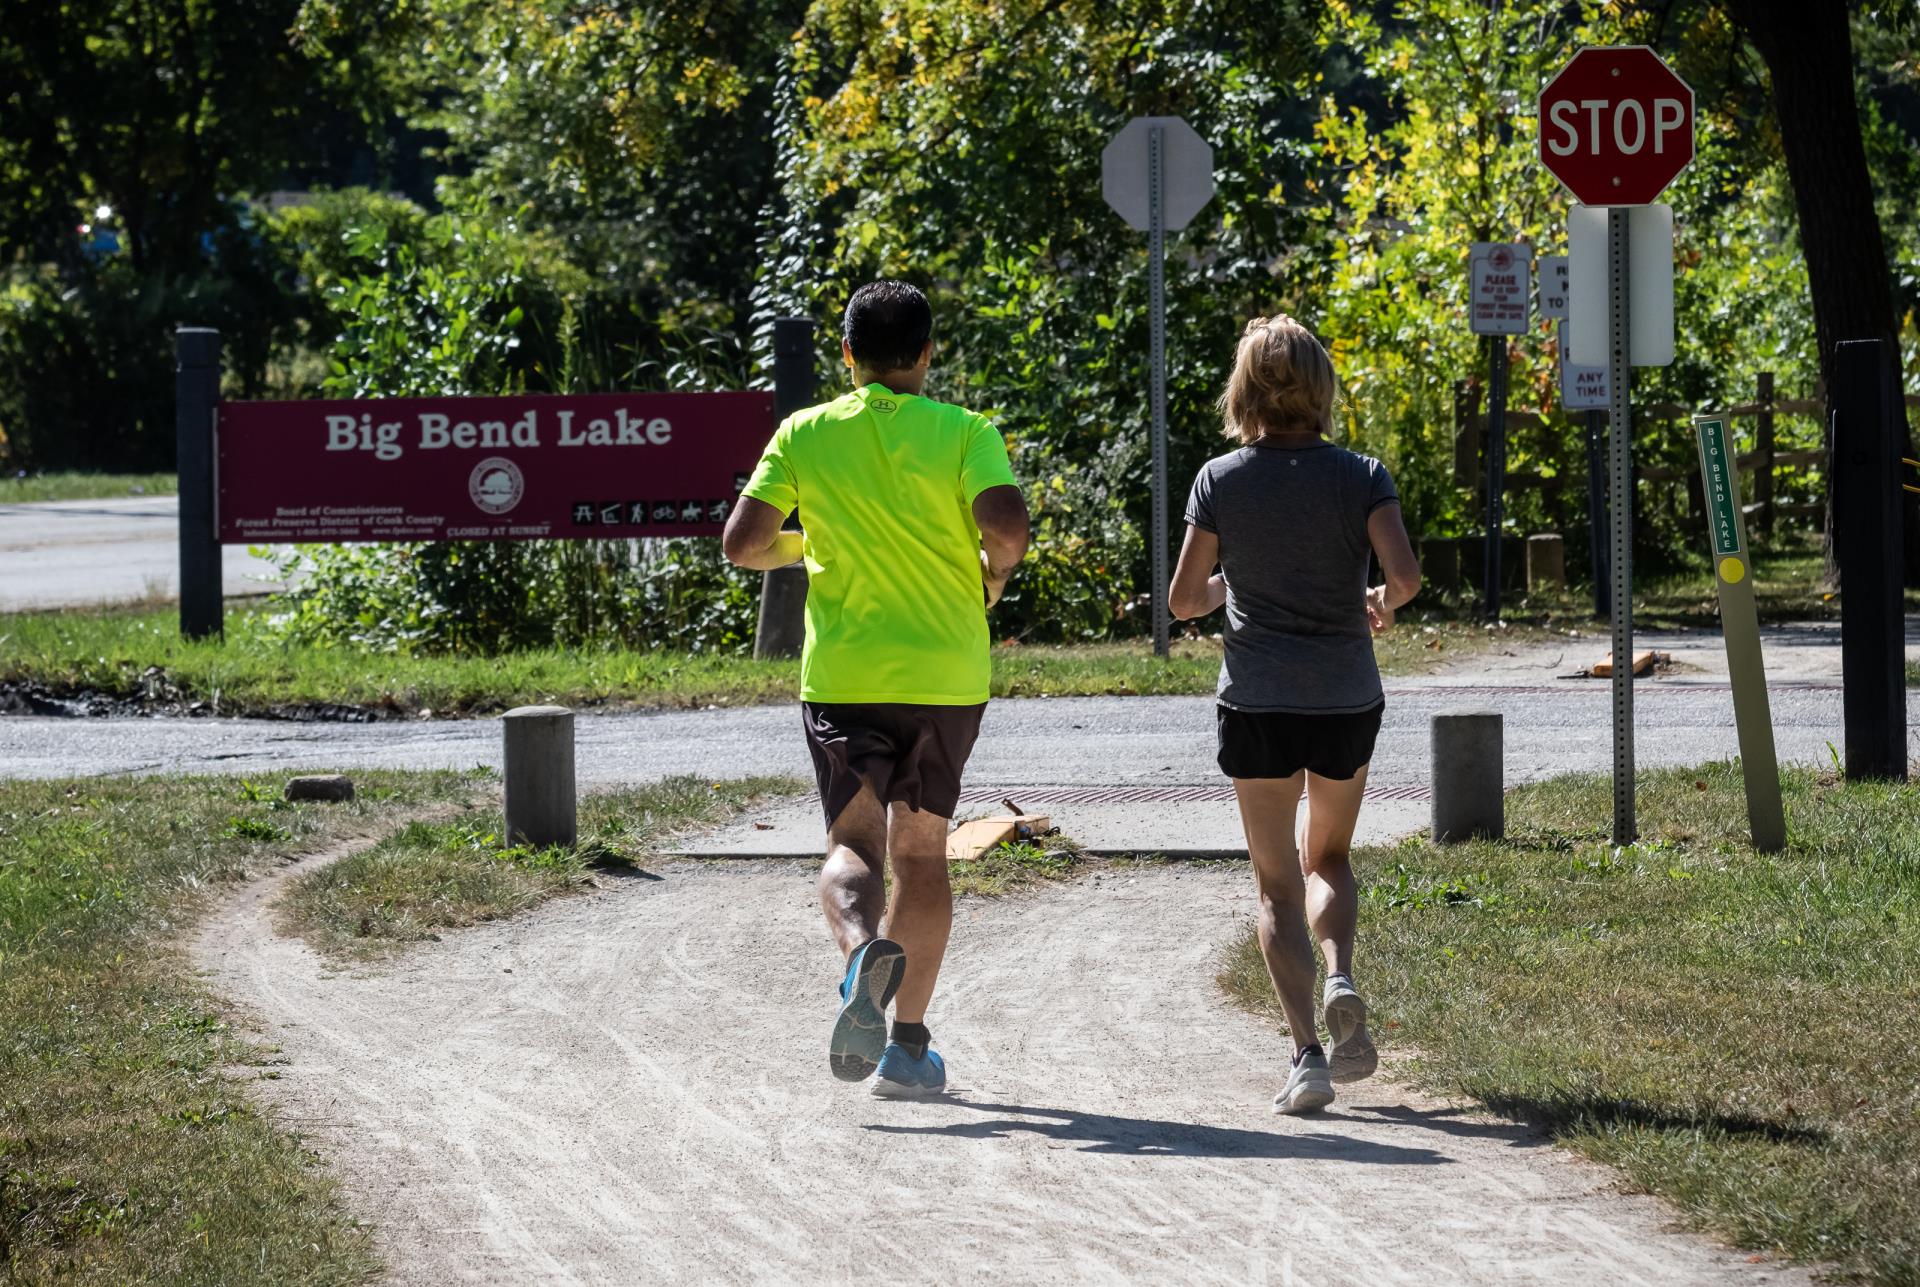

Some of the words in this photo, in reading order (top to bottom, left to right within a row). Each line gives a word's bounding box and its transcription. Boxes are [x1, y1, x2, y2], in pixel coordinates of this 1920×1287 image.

[1548, 98, 1685, 156] STOP
[1485, 275, 1516, 285] PLEASE
[1548, 298, 1563, 308] TO
[1577, 372, 1603, 383] ANY
[1576, 386, 1606, 397] TIME
[325, 413, 402, 460] Big
[418, 410, 540, 449] Bend
[557, 408, 672, 446] Lake
[1707, 427, 1718, 456] BIG
[1713, 464, 1724, 502] BEND
[1720, 511, 1731, 548] LAKE
[276, 507, 307, 516] Board
[309, 506, 321, 515] of
[323, 505, 403, 515] Commissioners
[235, 518, 269, 527] Forest
[272, 518, 316, 526] Preserve
[320, 516, 360, 526] District
[362, 516, 375, 525] of
[376, 515, 403, 525] Cook
[406, 515, 445, 526] County
[446, 526, 489, 536] CLOSED
[491, 526, 507, 535] AT
[509, 525, 551, 535] SUNSET
